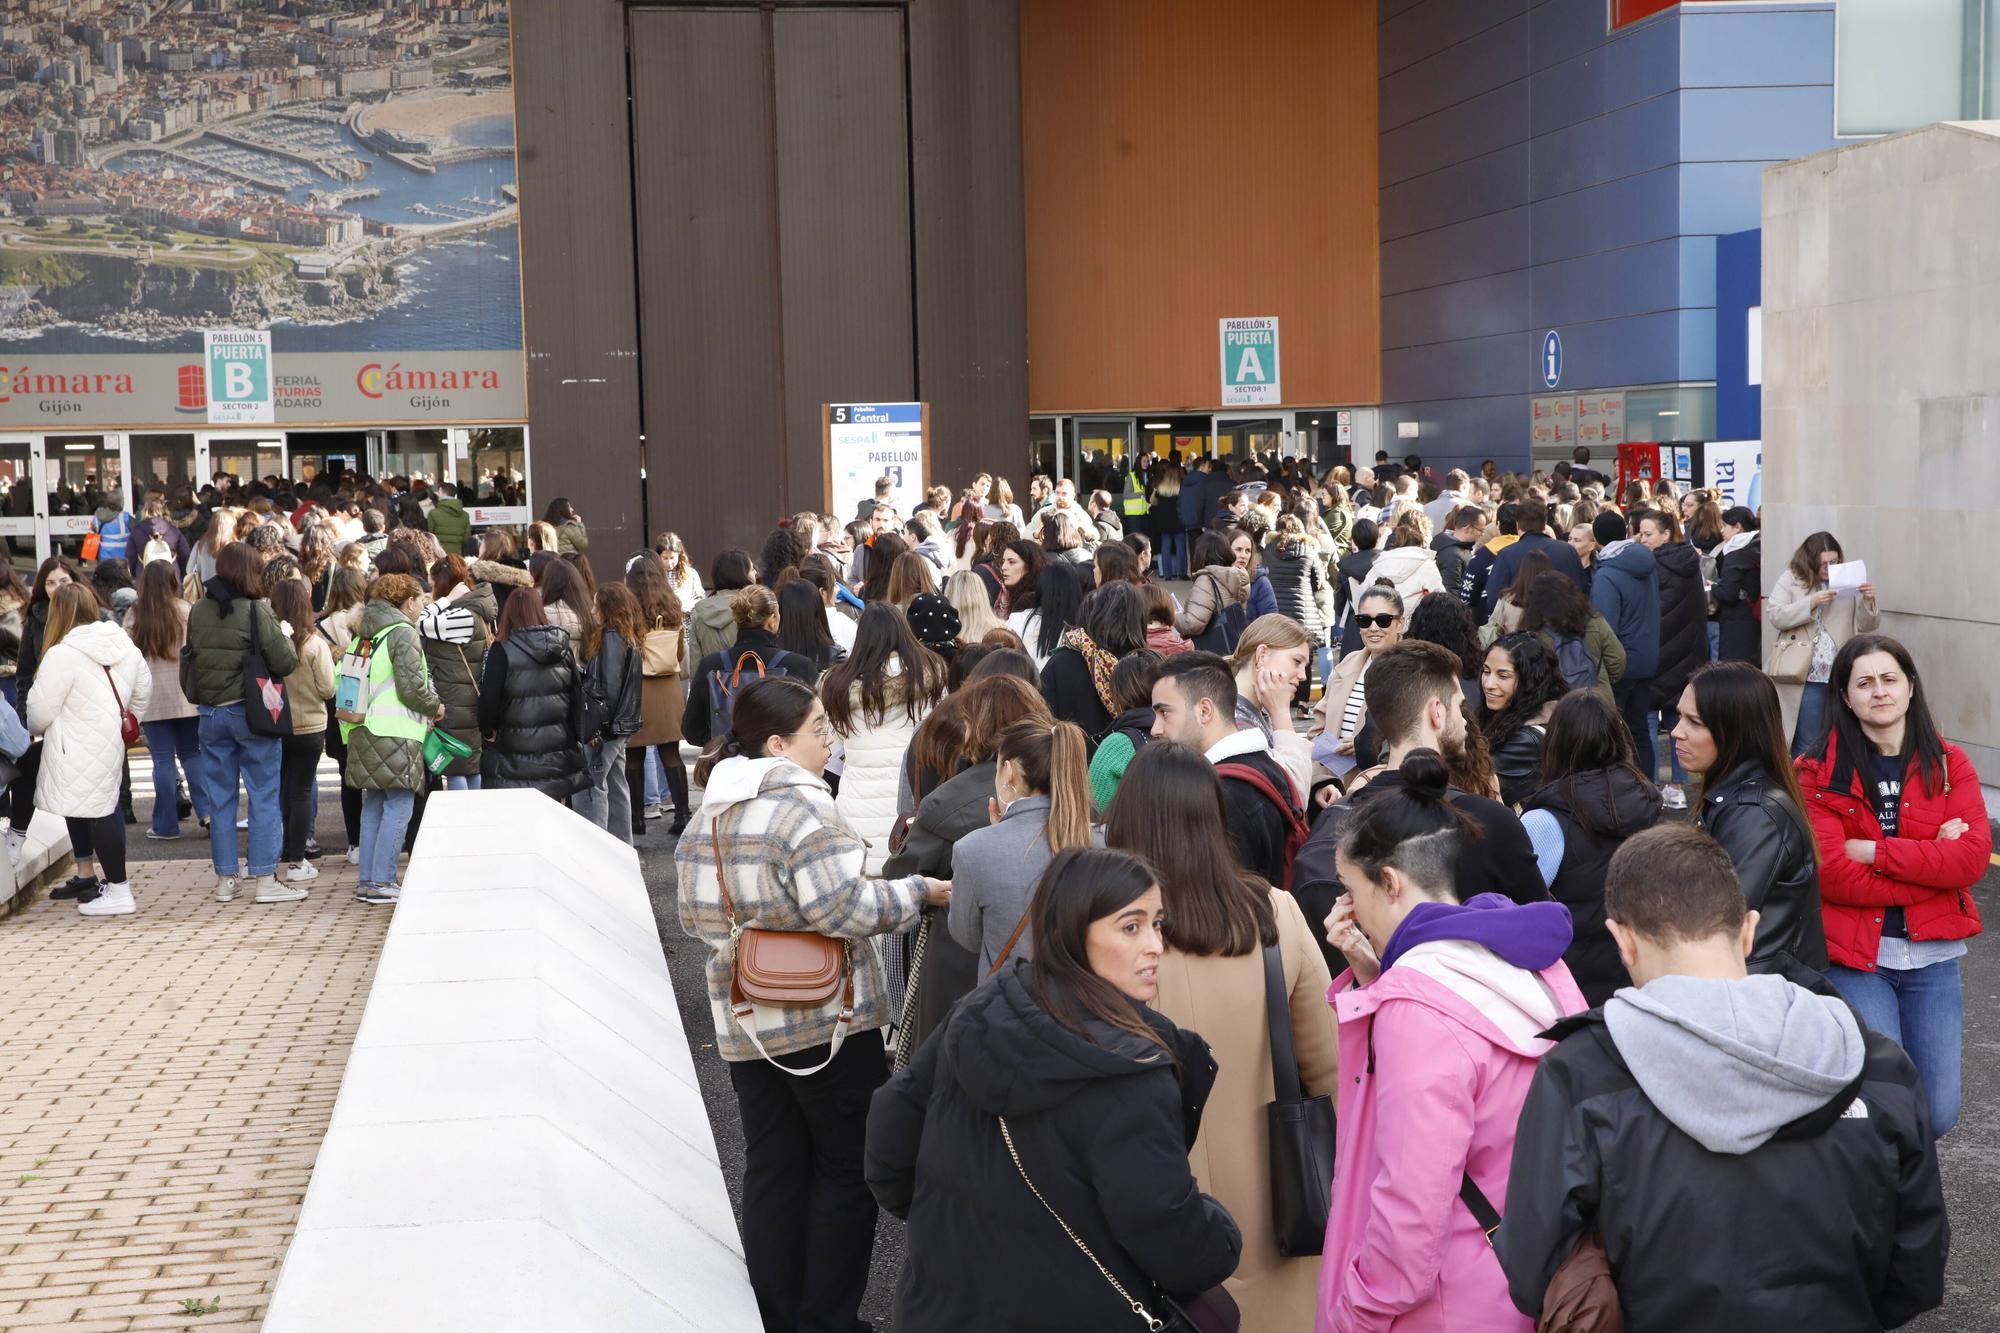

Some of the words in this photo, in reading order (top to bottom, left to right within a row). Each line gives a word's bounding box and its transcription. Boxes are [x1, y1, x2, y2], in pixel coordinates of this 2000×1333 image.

[1227, 319, 1264, 329] PABELLÓN
[1267, 320, 1272, 328] 5
[212, 333, 256, 343] PABELLÓN
[258, 334, 263, 342] 5
[1228, 332, 1271, 346] PUERTA
[214, 346, 263, 360] PUERTA
[1236, 347, 1265, 382] A
[225, 362, 254, 398] B
[275, 376, 320, 386] FERIAL
[357, 363, 500, 398] Cámara
[40, 400, 82, 416] Gijón
[274, 398, 322, 408] ADARO
[410, 396, 450, 410] Gijón
[836, 408, 846, 422] 5
[854, 413, 889, 422] Central
[838, 436, 871, 444] SESPA
[869, 450, 918, 462] PABELLÓN
